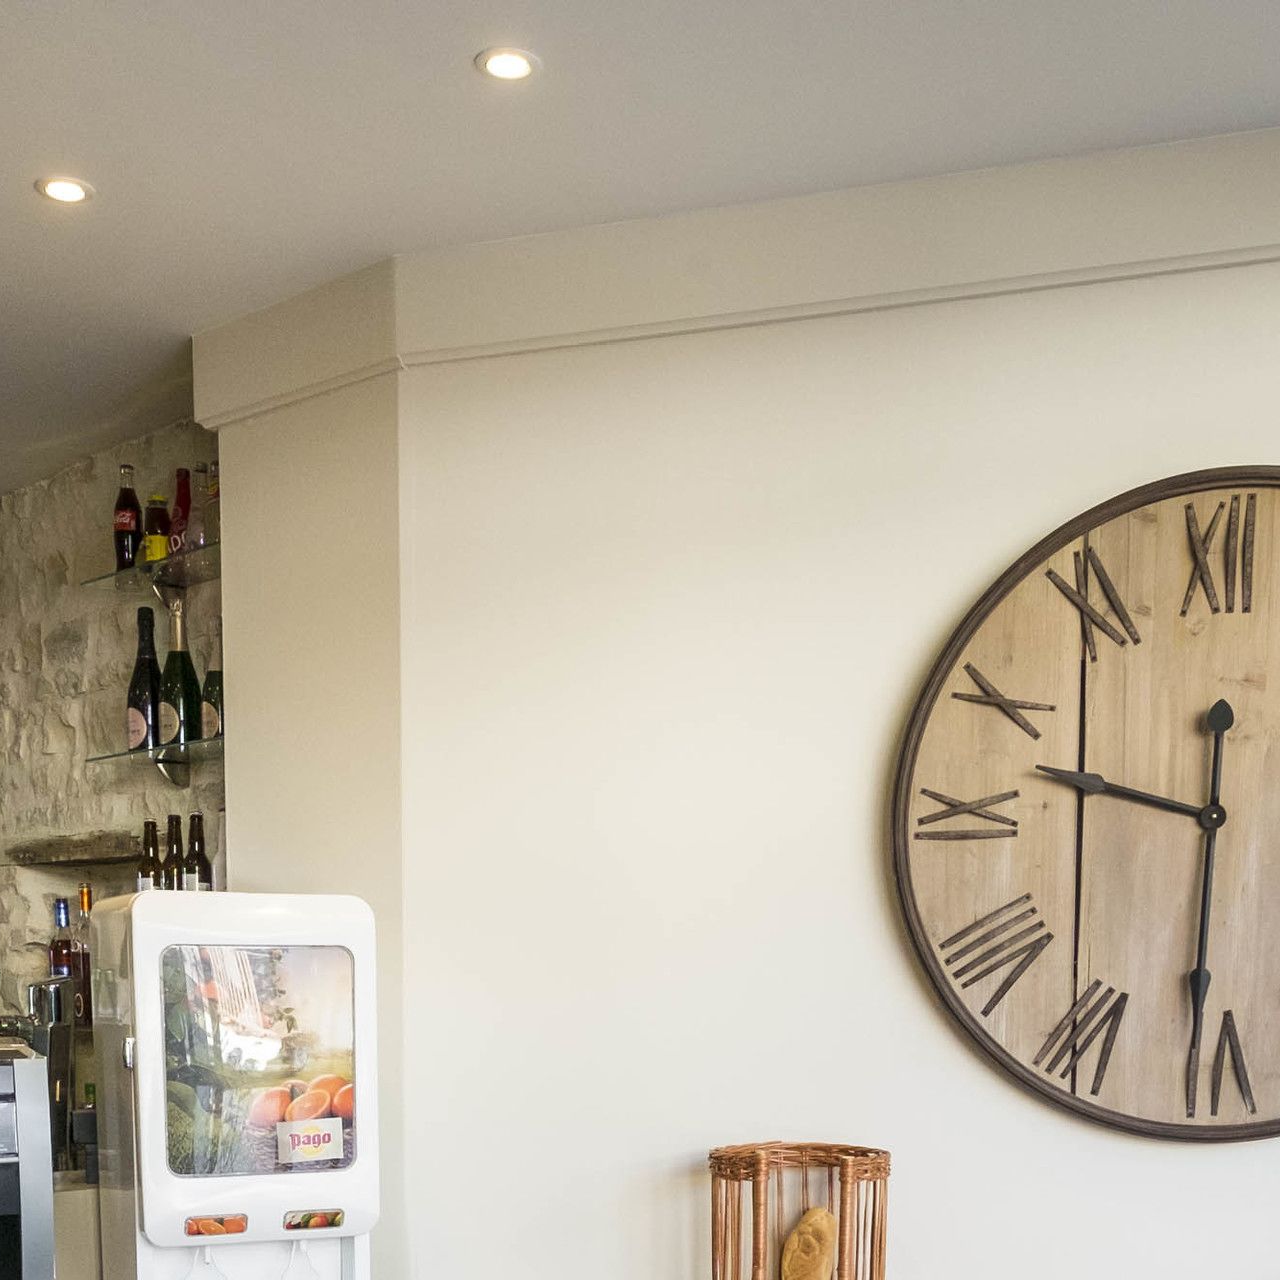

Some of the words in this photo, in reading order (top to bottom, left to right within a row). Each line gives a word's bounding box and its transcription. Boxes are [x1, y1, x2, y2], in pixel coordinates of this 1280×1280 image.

[1179, 493, 1257, 617] XII
[1046, 546, 1141, 662] XI
[951, 662, 1057, 741] X
[914, 787, 1020, 841] IX
[289, 1131, 332, 1152] pago
